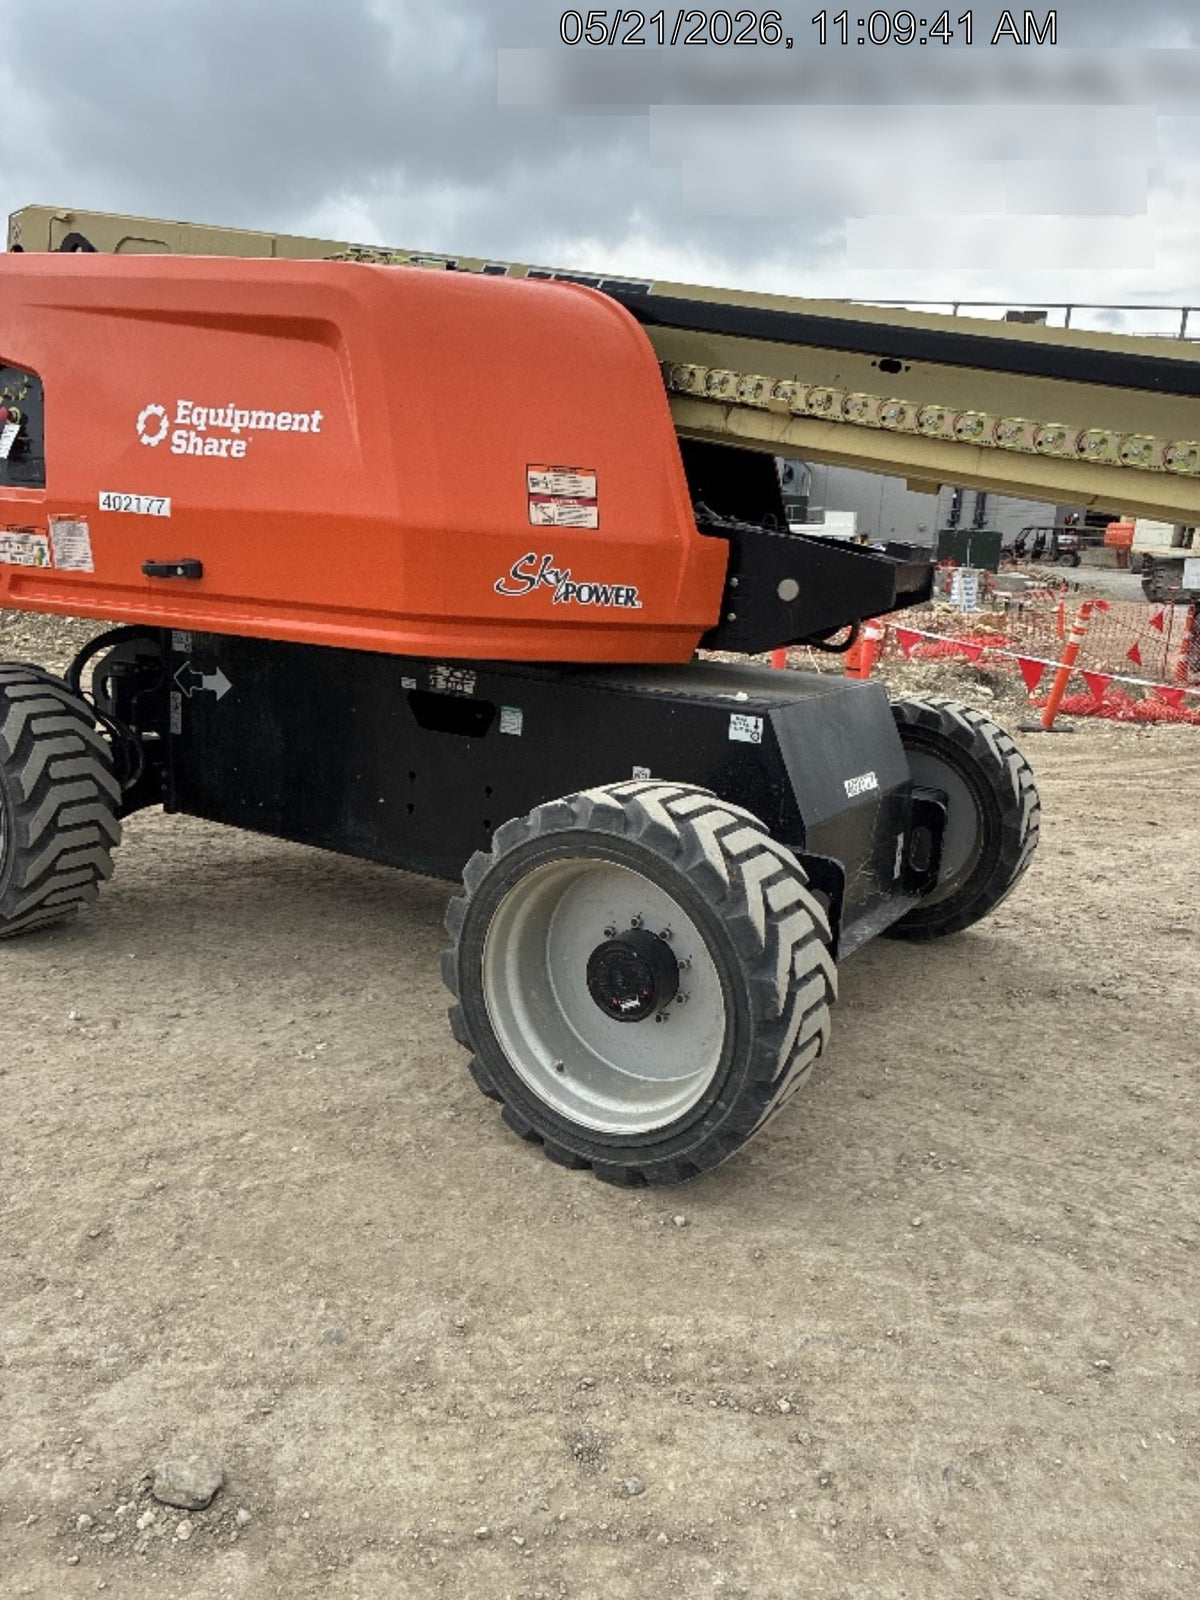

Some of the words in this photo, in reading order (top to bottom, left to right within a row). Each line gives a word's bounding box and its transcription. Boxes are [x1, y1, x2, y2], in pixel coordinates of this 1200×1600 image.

[174, 400, 323, 433] Equipment
[170, 430, 247, 458] Share
[102, 494, 166, 515] 402177
